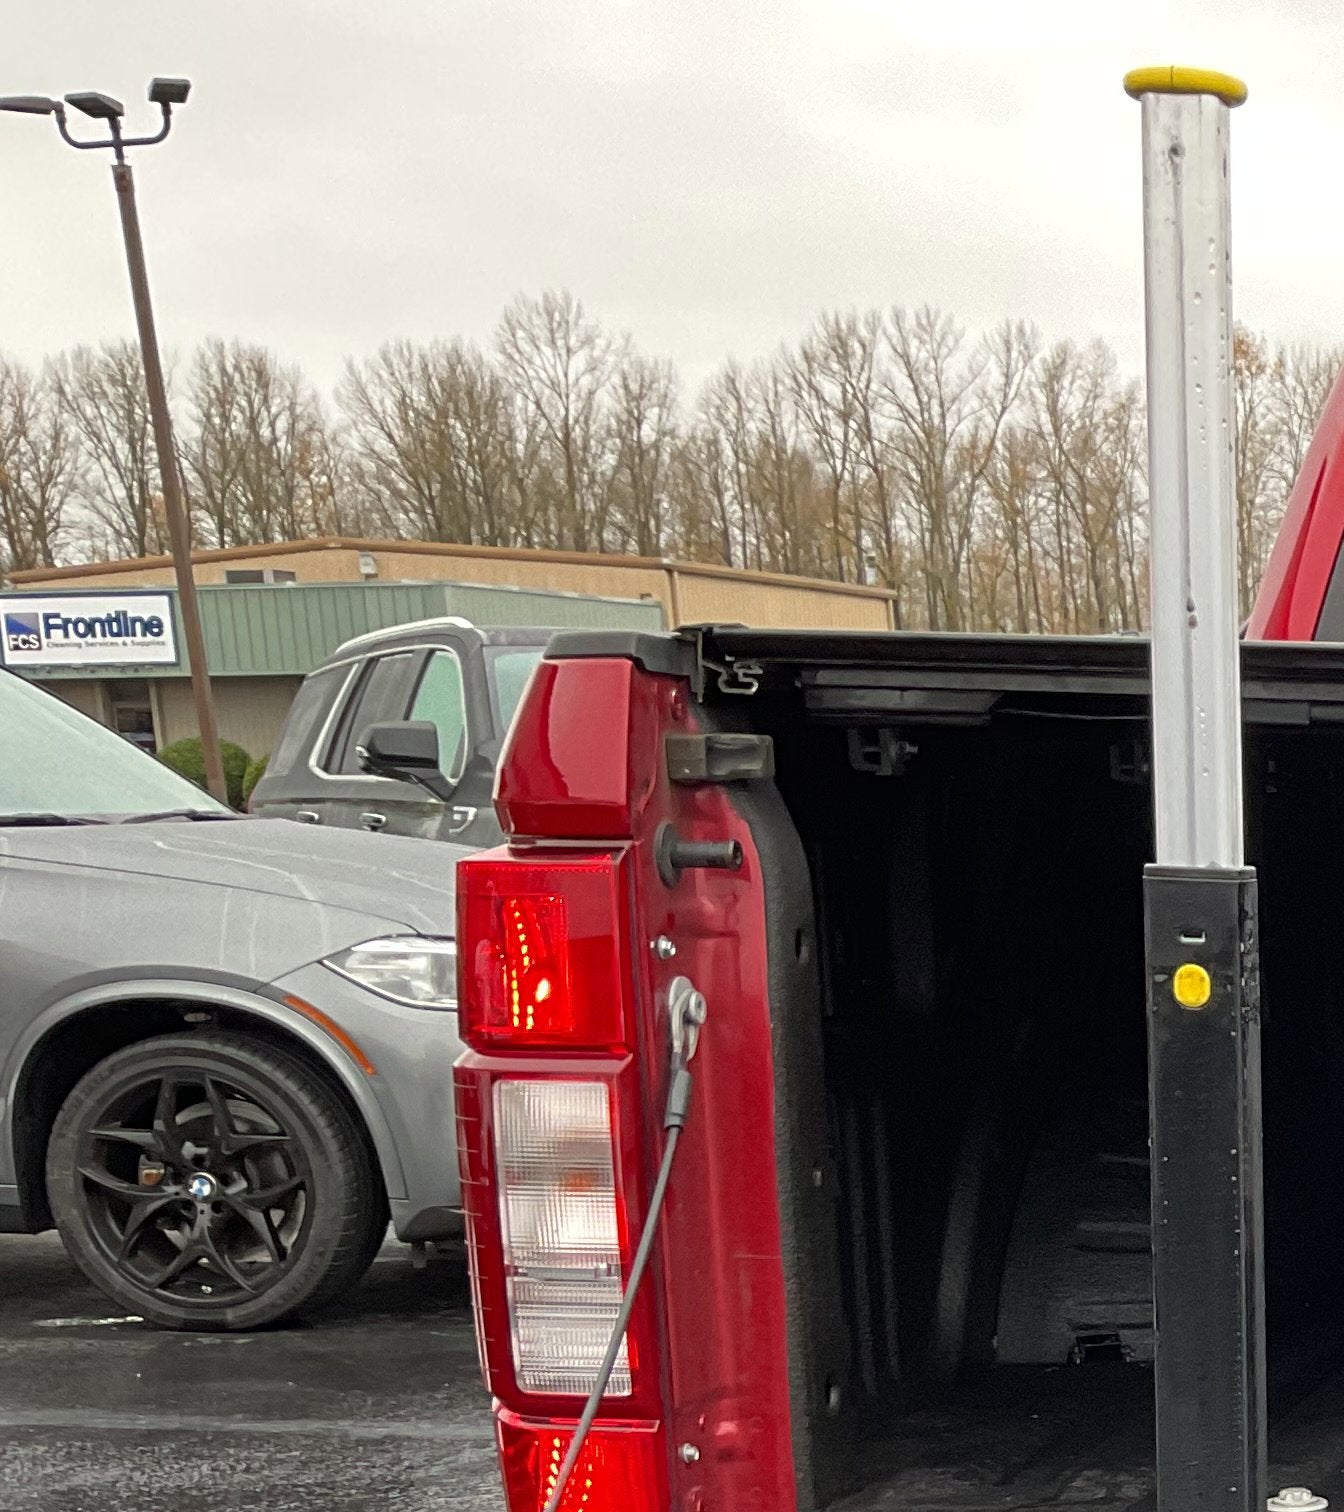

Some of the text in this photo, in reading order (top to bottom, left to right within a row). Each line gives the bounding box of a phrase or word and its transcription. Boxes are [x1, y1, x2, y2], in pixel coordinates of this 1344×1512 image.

[43, 610, 165, 640] Frontline
[9, 634, 41, 649] FCS
[46, 640, 82, 649] Cleaning
[85, 640, 119, 648] Services
[131, 640, 166, 648] Supplies
